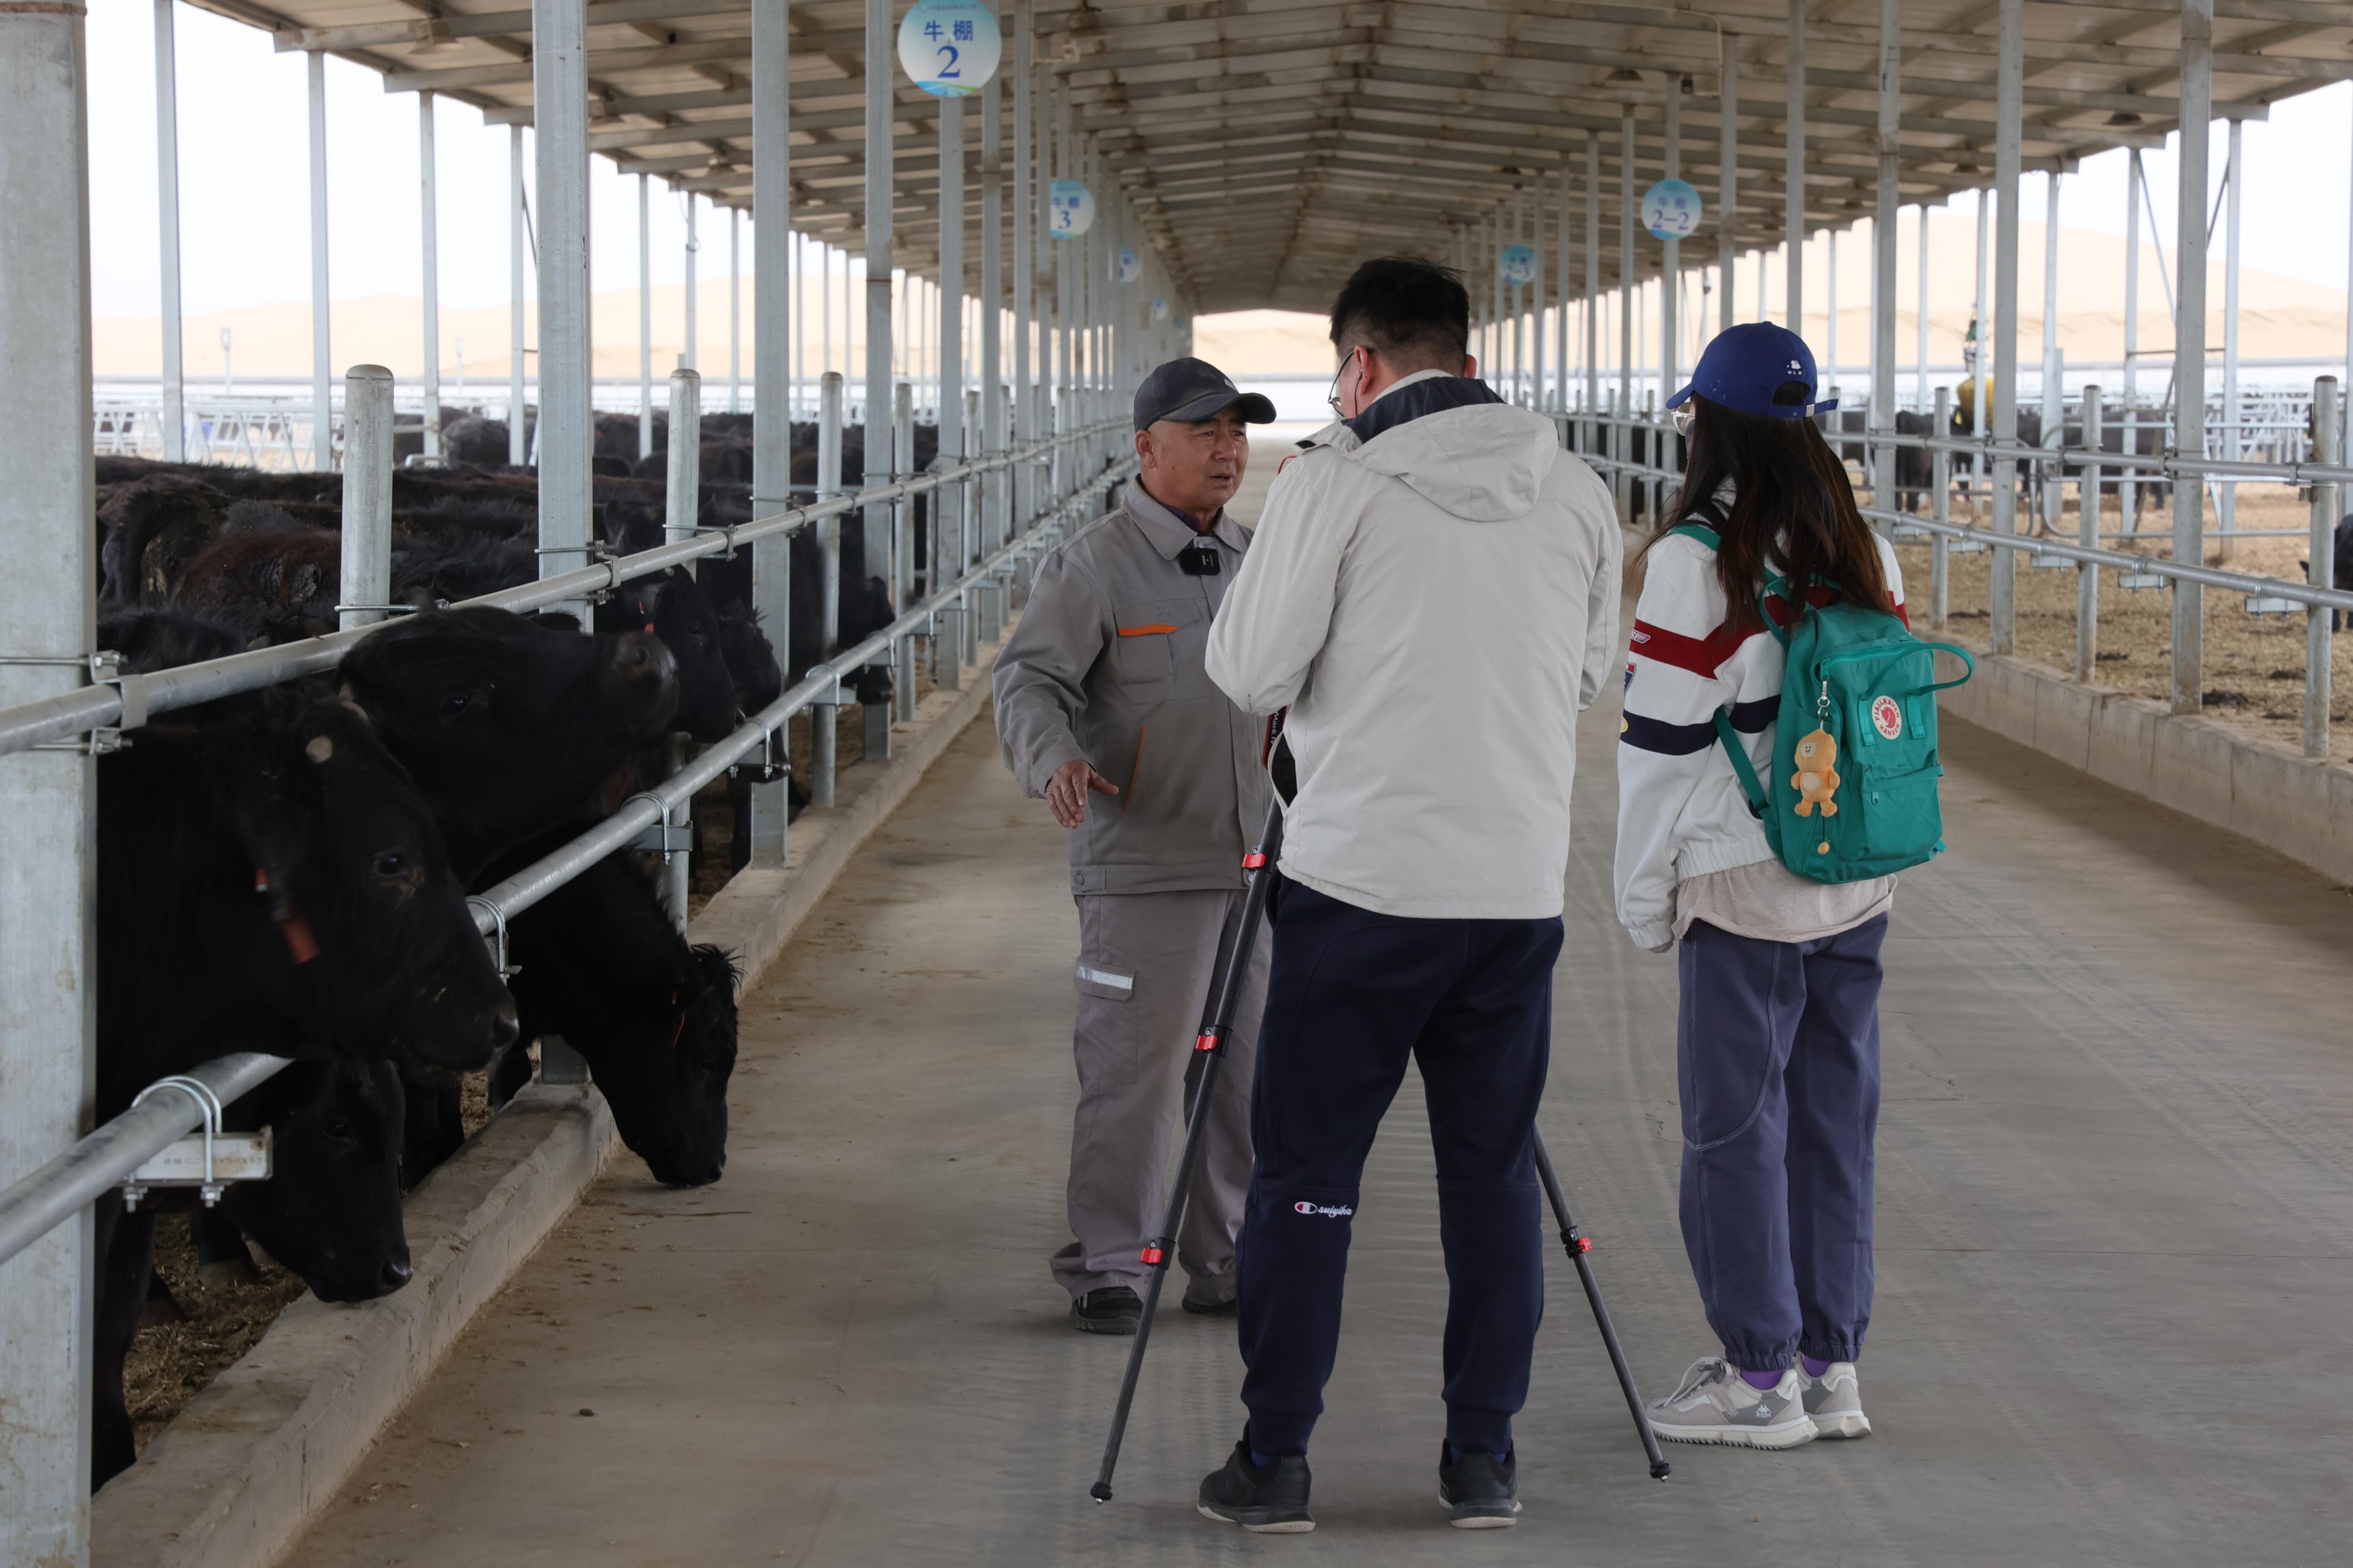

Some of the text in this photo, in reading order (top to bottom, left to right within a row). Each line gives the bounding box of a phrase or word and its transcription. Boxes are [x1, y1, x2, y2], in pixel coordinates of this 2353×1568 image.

[923, 20, 973, 42] 牛棚
[937, 45, 961, 78] 2
[1058, 211, 1072, 230] 3
